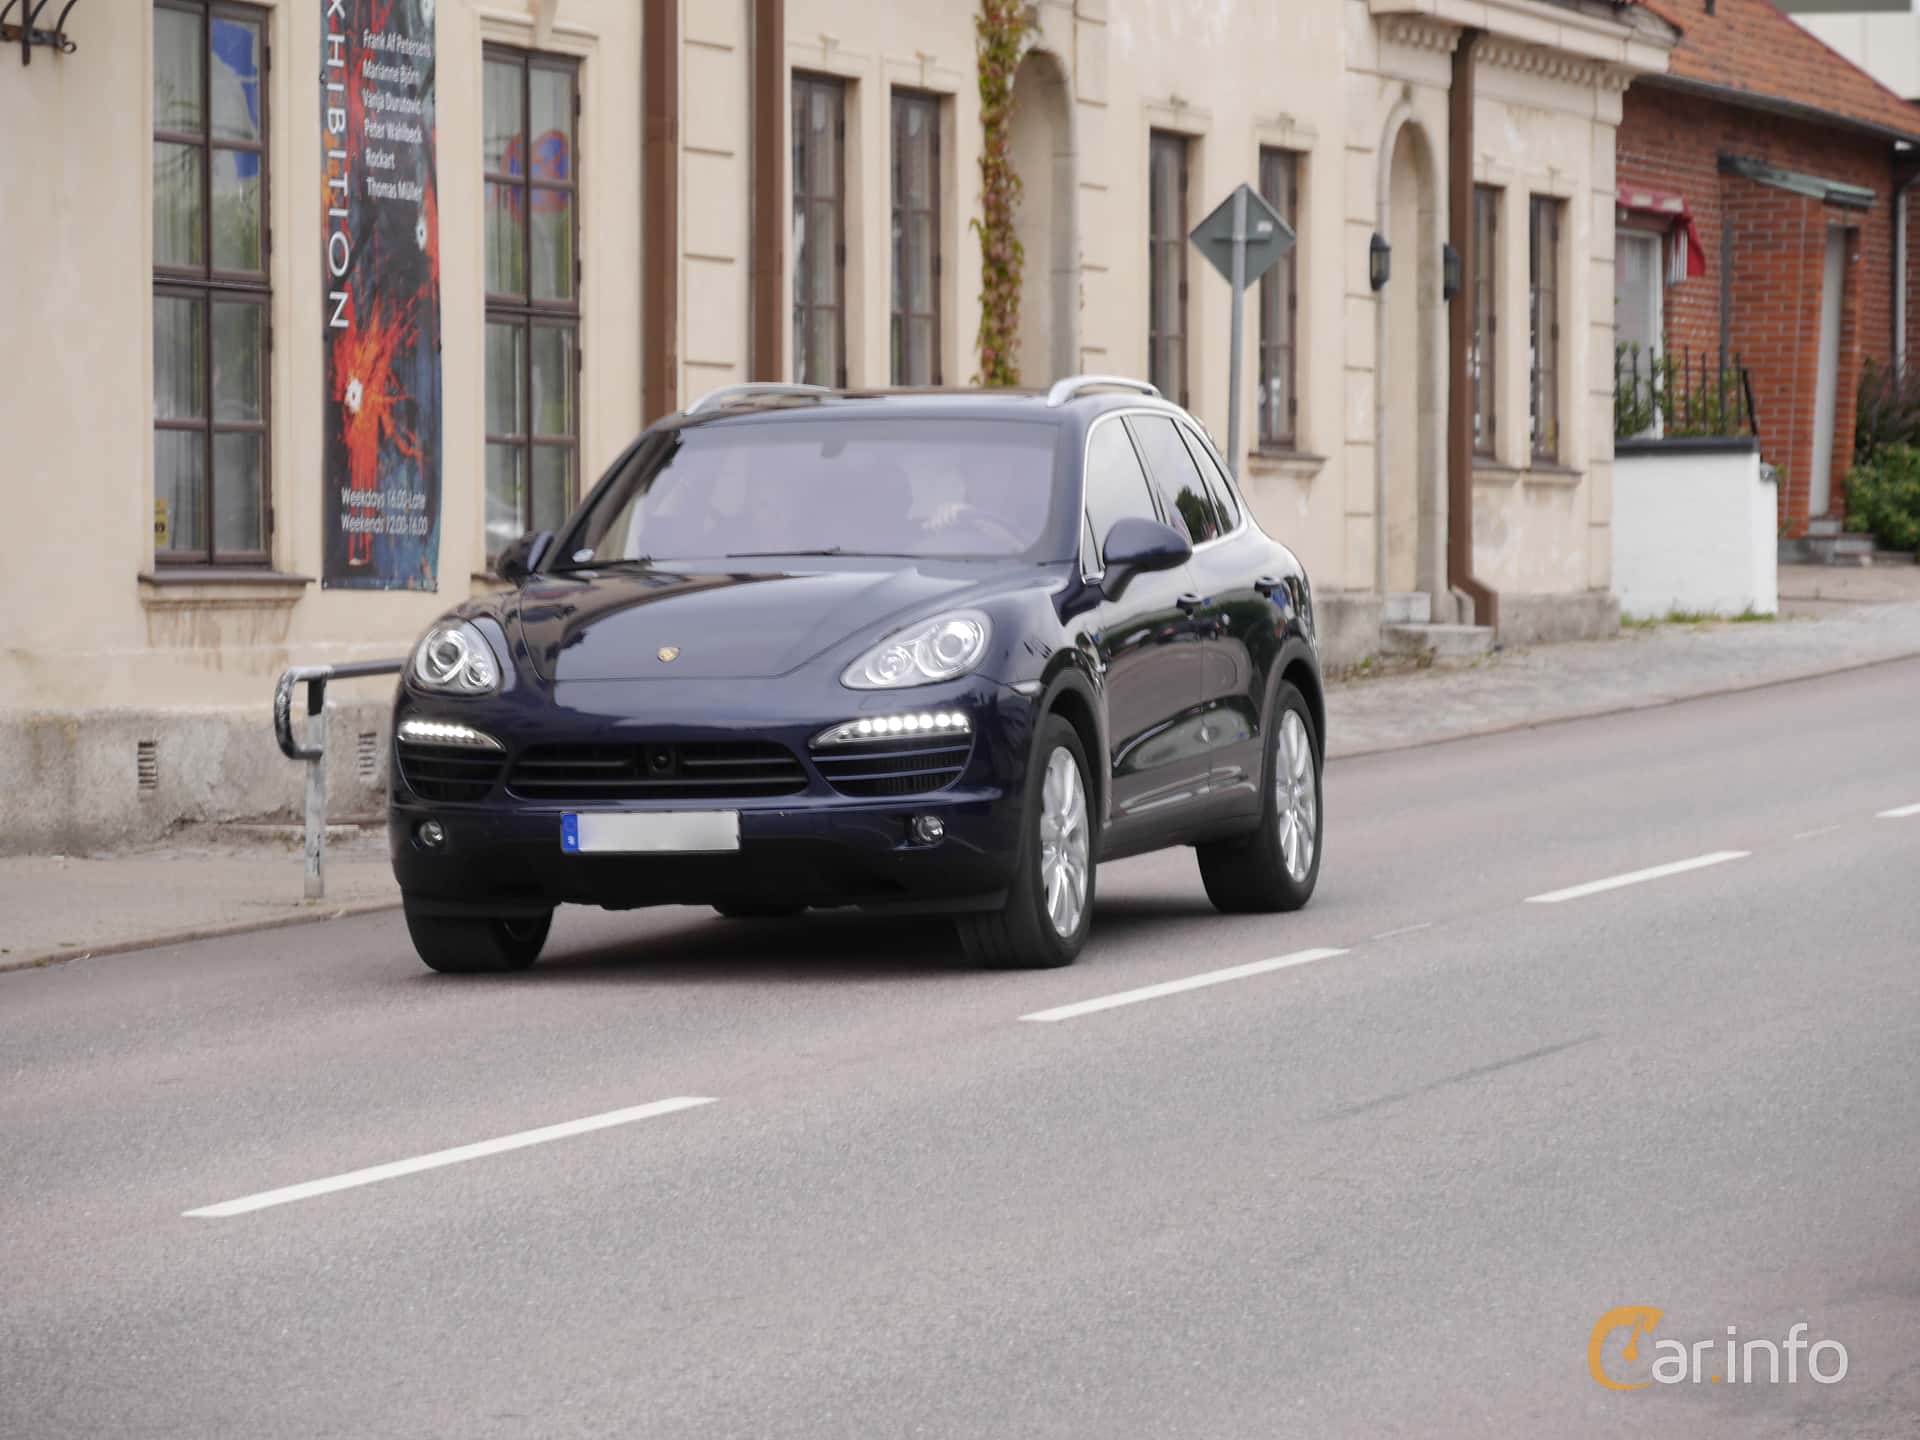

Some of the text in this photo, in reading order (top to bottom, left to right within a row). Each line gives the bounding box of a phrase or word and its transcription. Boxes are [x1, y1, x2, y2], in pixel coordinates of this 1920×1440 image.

[362, 28, 385, 49] Frank
[362, 58, 400, 81] Marianne
[362, 88, 384, 112] Vanja
[364, 118, 423, 144] Peter Wahlbeck
[365, 147, 396, 170] Rockart
[366, 176, 423, 202] Thomas Müller
[341, 487, 385, 511] Weekdays
[341, 513, 385, 533] Weekends
